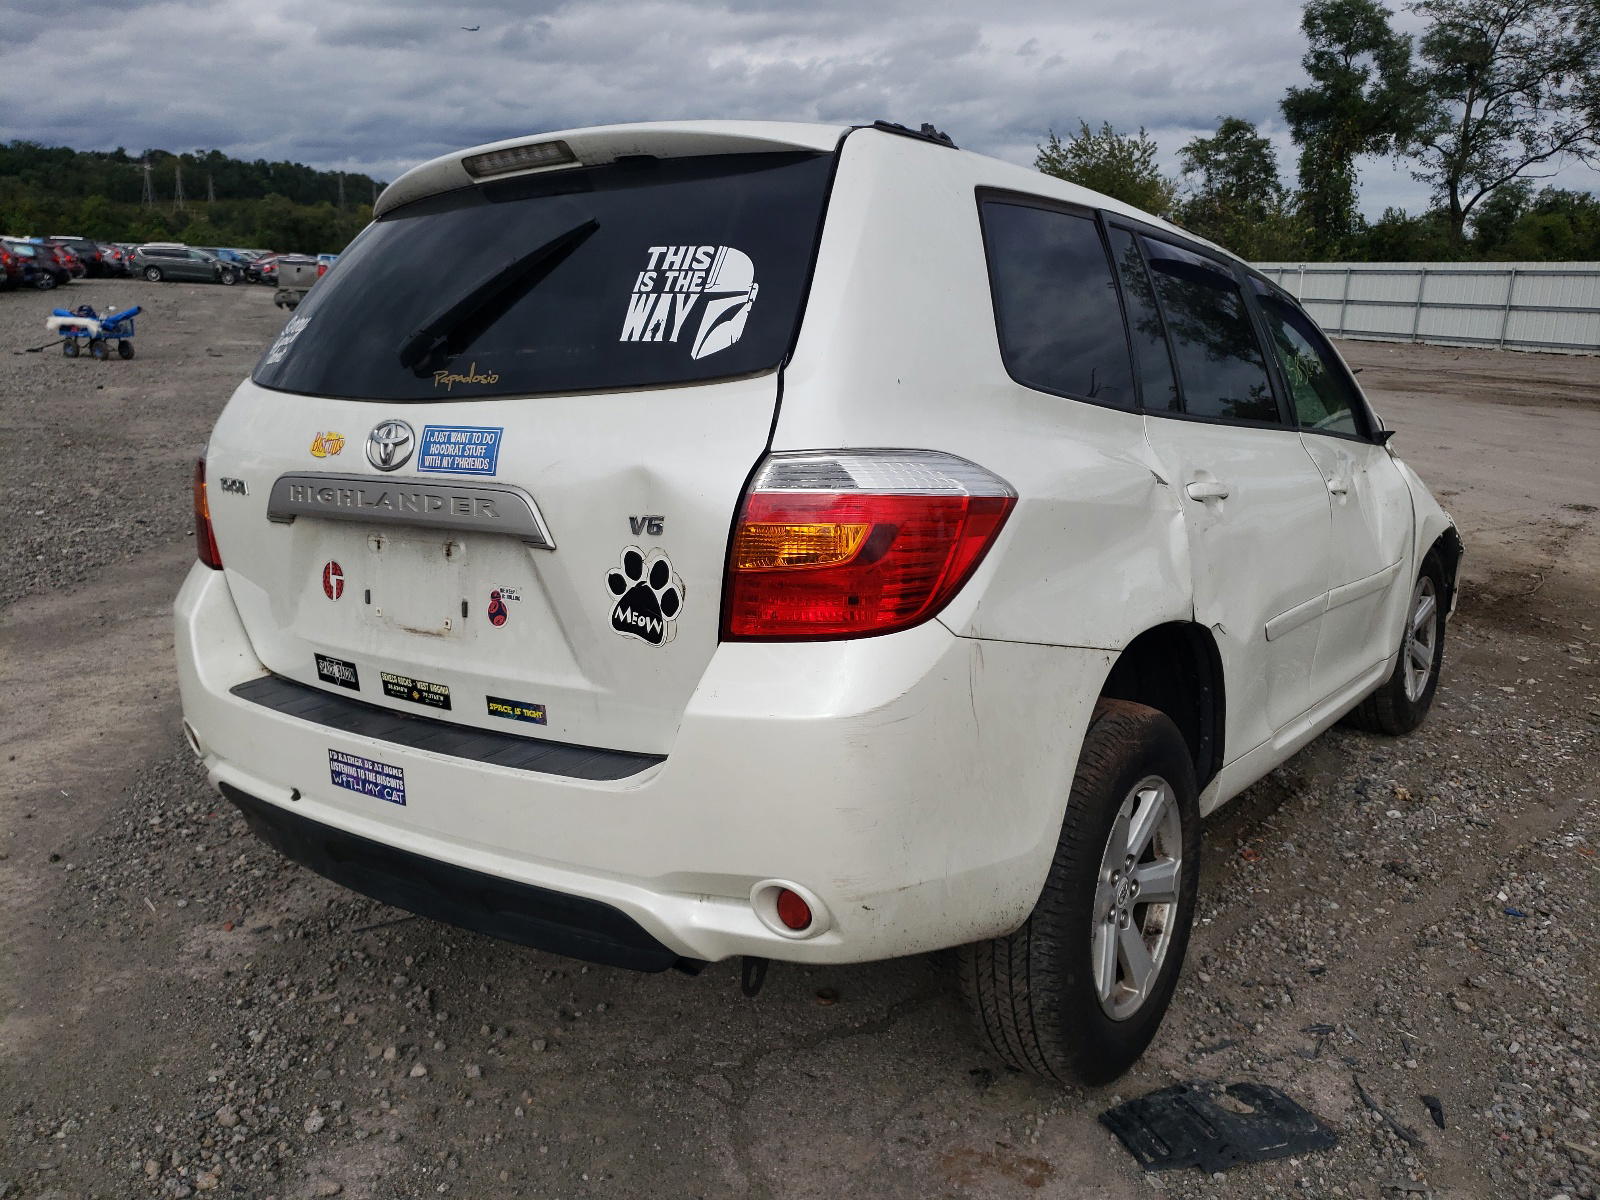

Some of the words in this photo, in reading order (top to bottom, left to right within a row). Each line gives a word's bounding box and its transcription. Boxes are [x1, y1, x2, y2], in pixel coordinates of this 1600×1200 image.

[647, 246, 716, 270] THIS
[633, 271, 657, 292] IS
[664, 271, 705, 293] THE
[619, 293, 700, 342] WAY
[426, 432, 431, 441] I
[431, 432, 450, 442] JUST
[450, 432, 471, 443] WANT
[472, 433, 482, 444] TO
[483, 433, 495, 444] DO
[429, 444, 464, 455] HOODRAT
[464, 445, 487, 457] STUFF
[424, 456, 441, 467] WITH
[441, 457, 453, 468] MY
[454, 457, 490, 469] PHRIENDS
[290, 484, 500, 518] HIGHLANDER
[629, 515, 665, 536] V6
[614, 605, 663, 635] MEOW
[490, 703, 512, 714] SPACE
[514, 707, 521, 715] IS
[522, 709, 543, 718] TIGHT
[330, 760, 357, 777] LISTENING
[357, 768, 365, 779] TO
[365, 771, 376, 782] THE
[376, 774, 404, 790] BISCUITS
[338, 754, 363, 767] RATHER
[364, 760, 373, 769] BE
[373, 763, 382, 772] AT
[383, 765, 403, 777] HOME
[333, 773, 362, 791] WITH
[365, 783, 380, 795] MY
[384, 788, 404, 804] CAT
